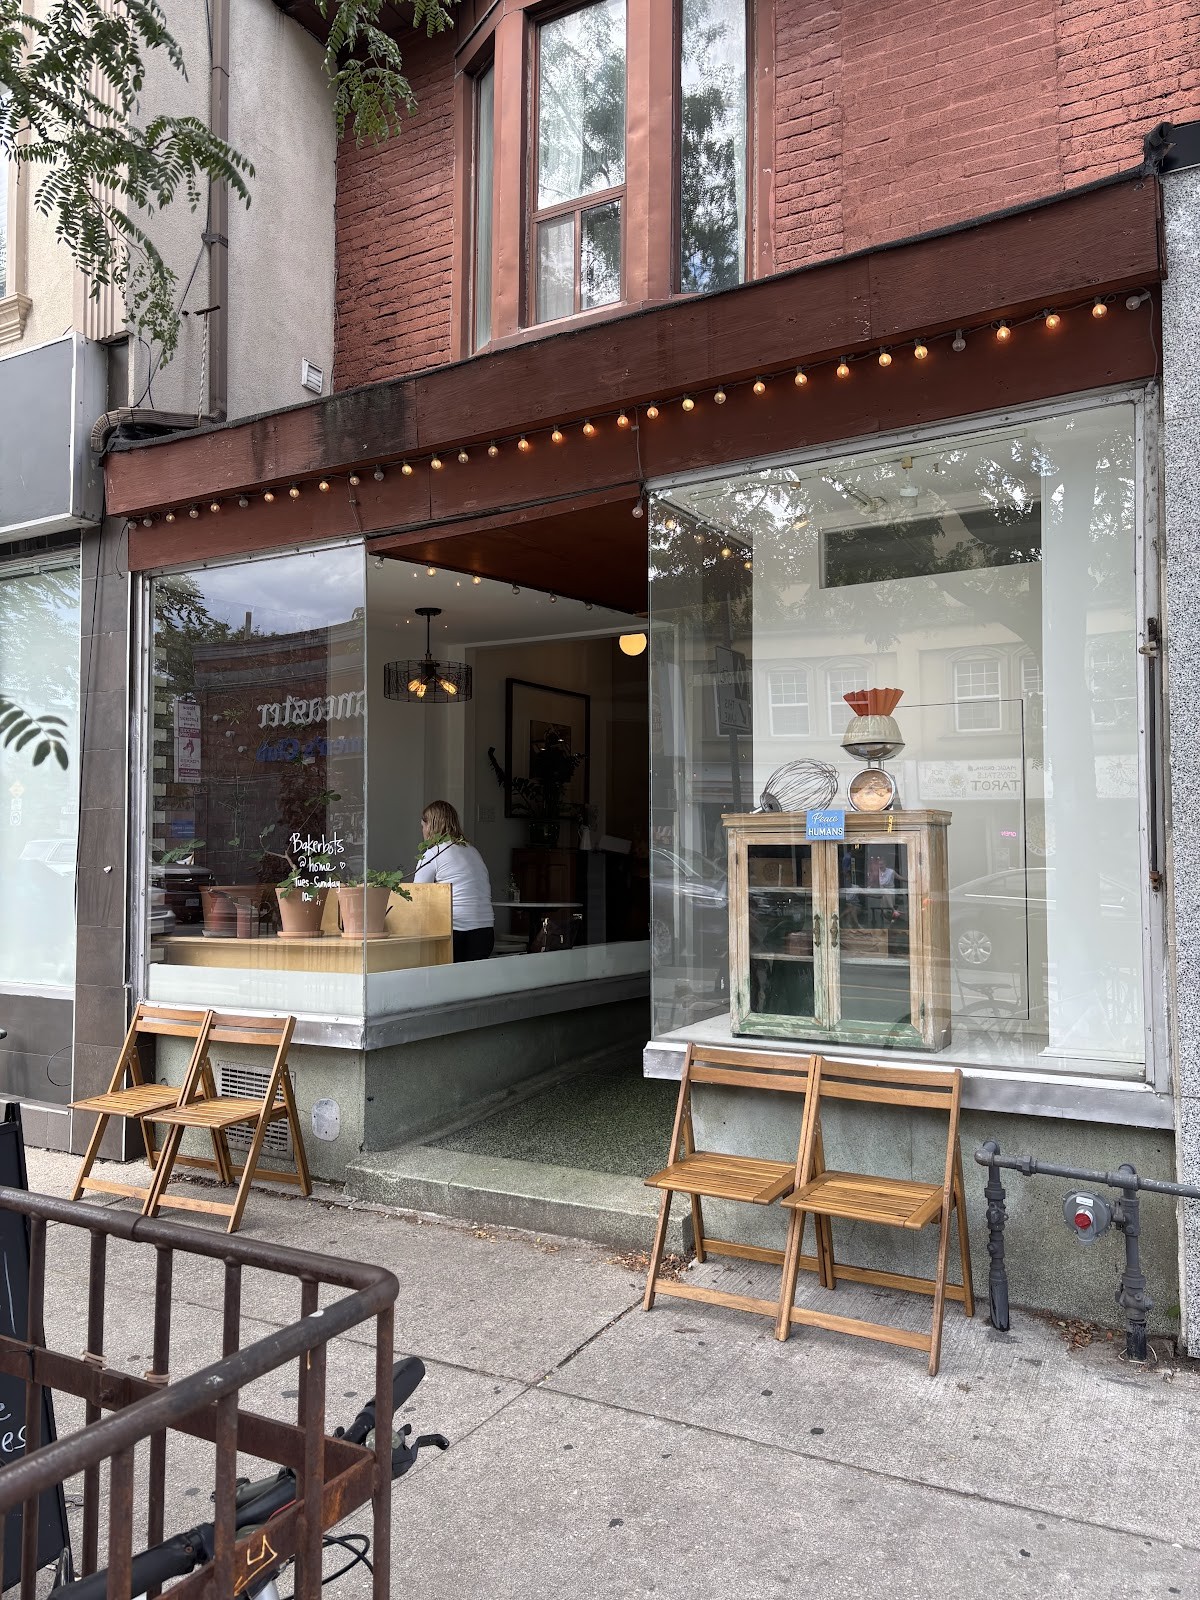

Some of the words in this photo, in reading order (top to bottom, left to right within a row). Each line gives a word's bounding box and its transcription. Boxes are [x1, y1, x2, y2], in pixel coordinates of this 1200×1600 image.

[811, 812, 839, 824] Peace
[808, 827, 843, 836] HUMANS
[290, 832, 345, 856] Bakerbots
